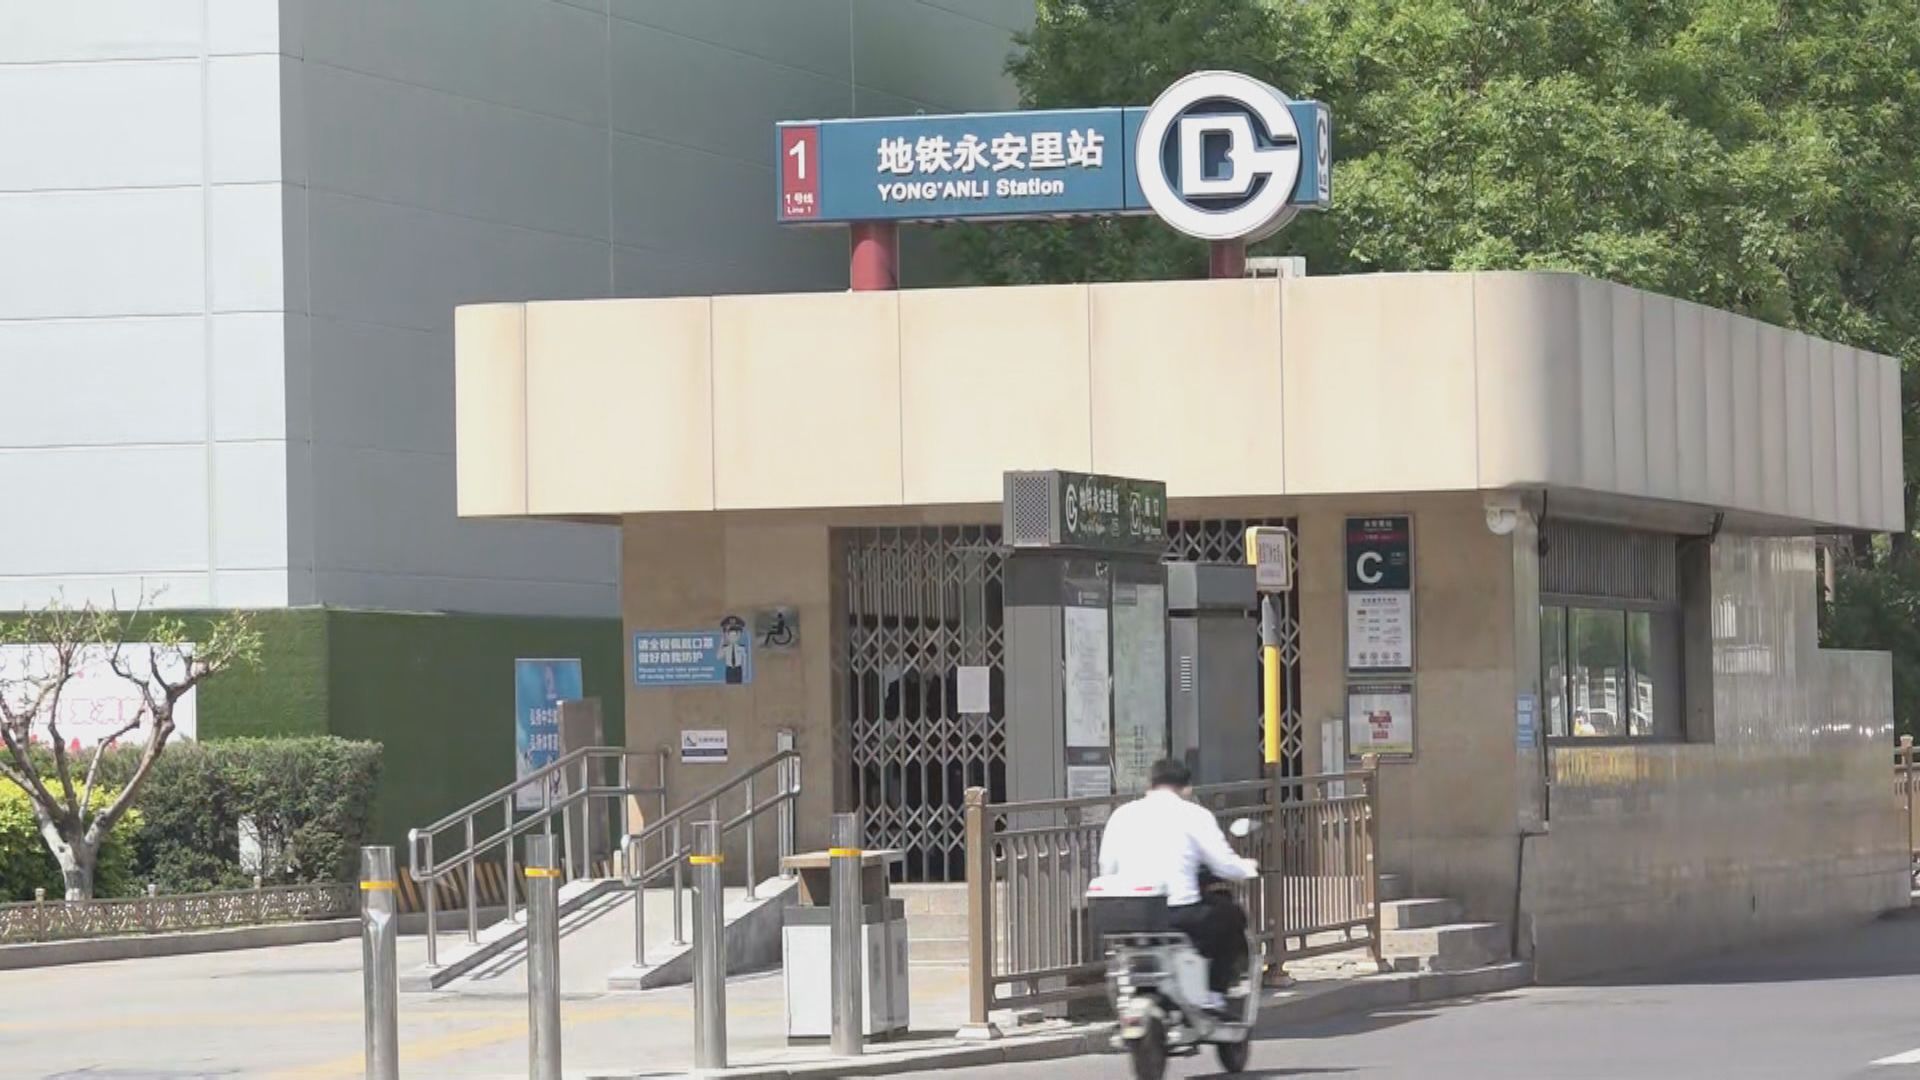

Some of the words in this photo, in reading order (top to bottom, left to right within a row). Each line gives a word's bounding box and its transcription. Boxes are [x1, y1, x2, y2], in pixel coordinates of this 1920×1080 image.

[789, 139, 805, 179] 1
[877, 128, 1105, 173] 地铁永安里站
[878, 180, 989, 201] YONG'ANLI
[996, 178, 1065, 196] Station
[1356, 551, 1384, 584] C
